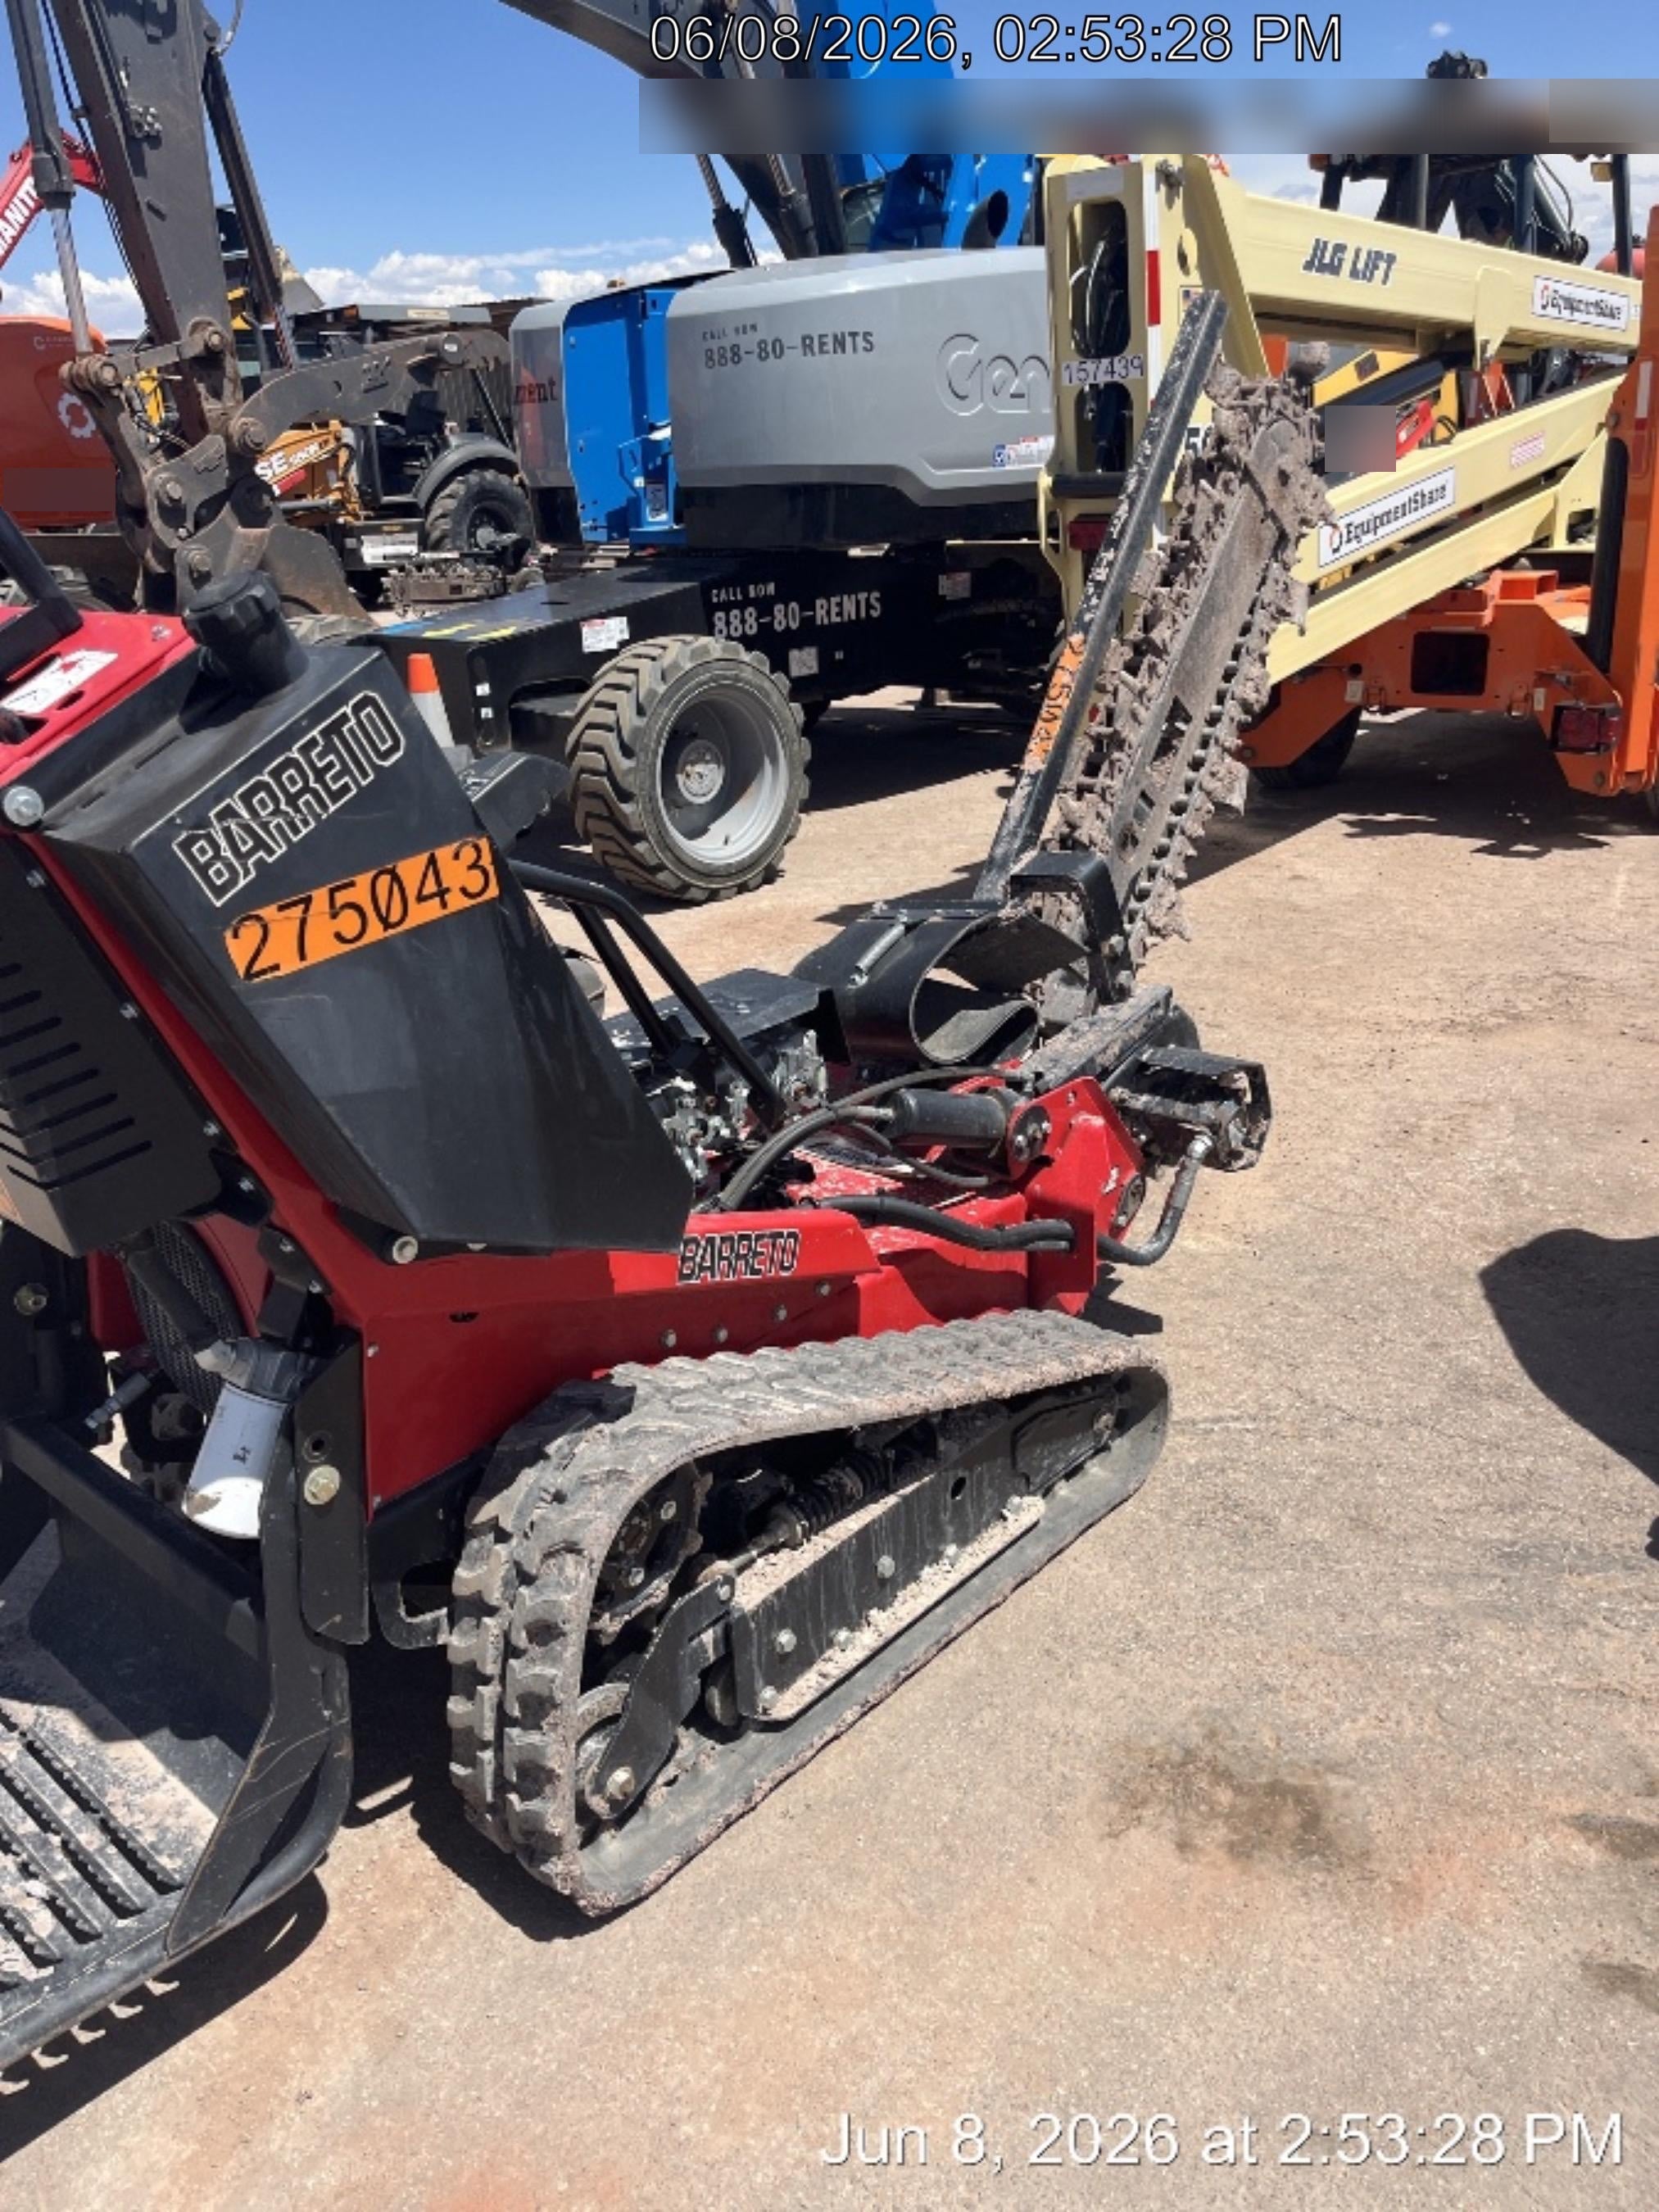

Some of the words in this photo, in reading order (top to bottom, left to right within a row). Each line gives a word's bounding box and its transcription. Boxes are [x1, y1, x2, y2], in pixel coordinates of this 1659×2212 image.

[1302, 238, 1348, 277] JLG
[1349, 246, 1397, 286] LIFT
[705, 331, 874, 369] 888-80-RENTS
[1063, 356, 1144, 384] 157439
[1344, 483, 1447, 544] EquipmentShare
[712, 587, 743, 603] CALL
[714, 591, 881, 640] 888-80-RENTS
[171, 691, 405, 906] BARRETO
[232, 840, 491, 981] 275043
[678, 1229, 801, 1285] BARRETO
